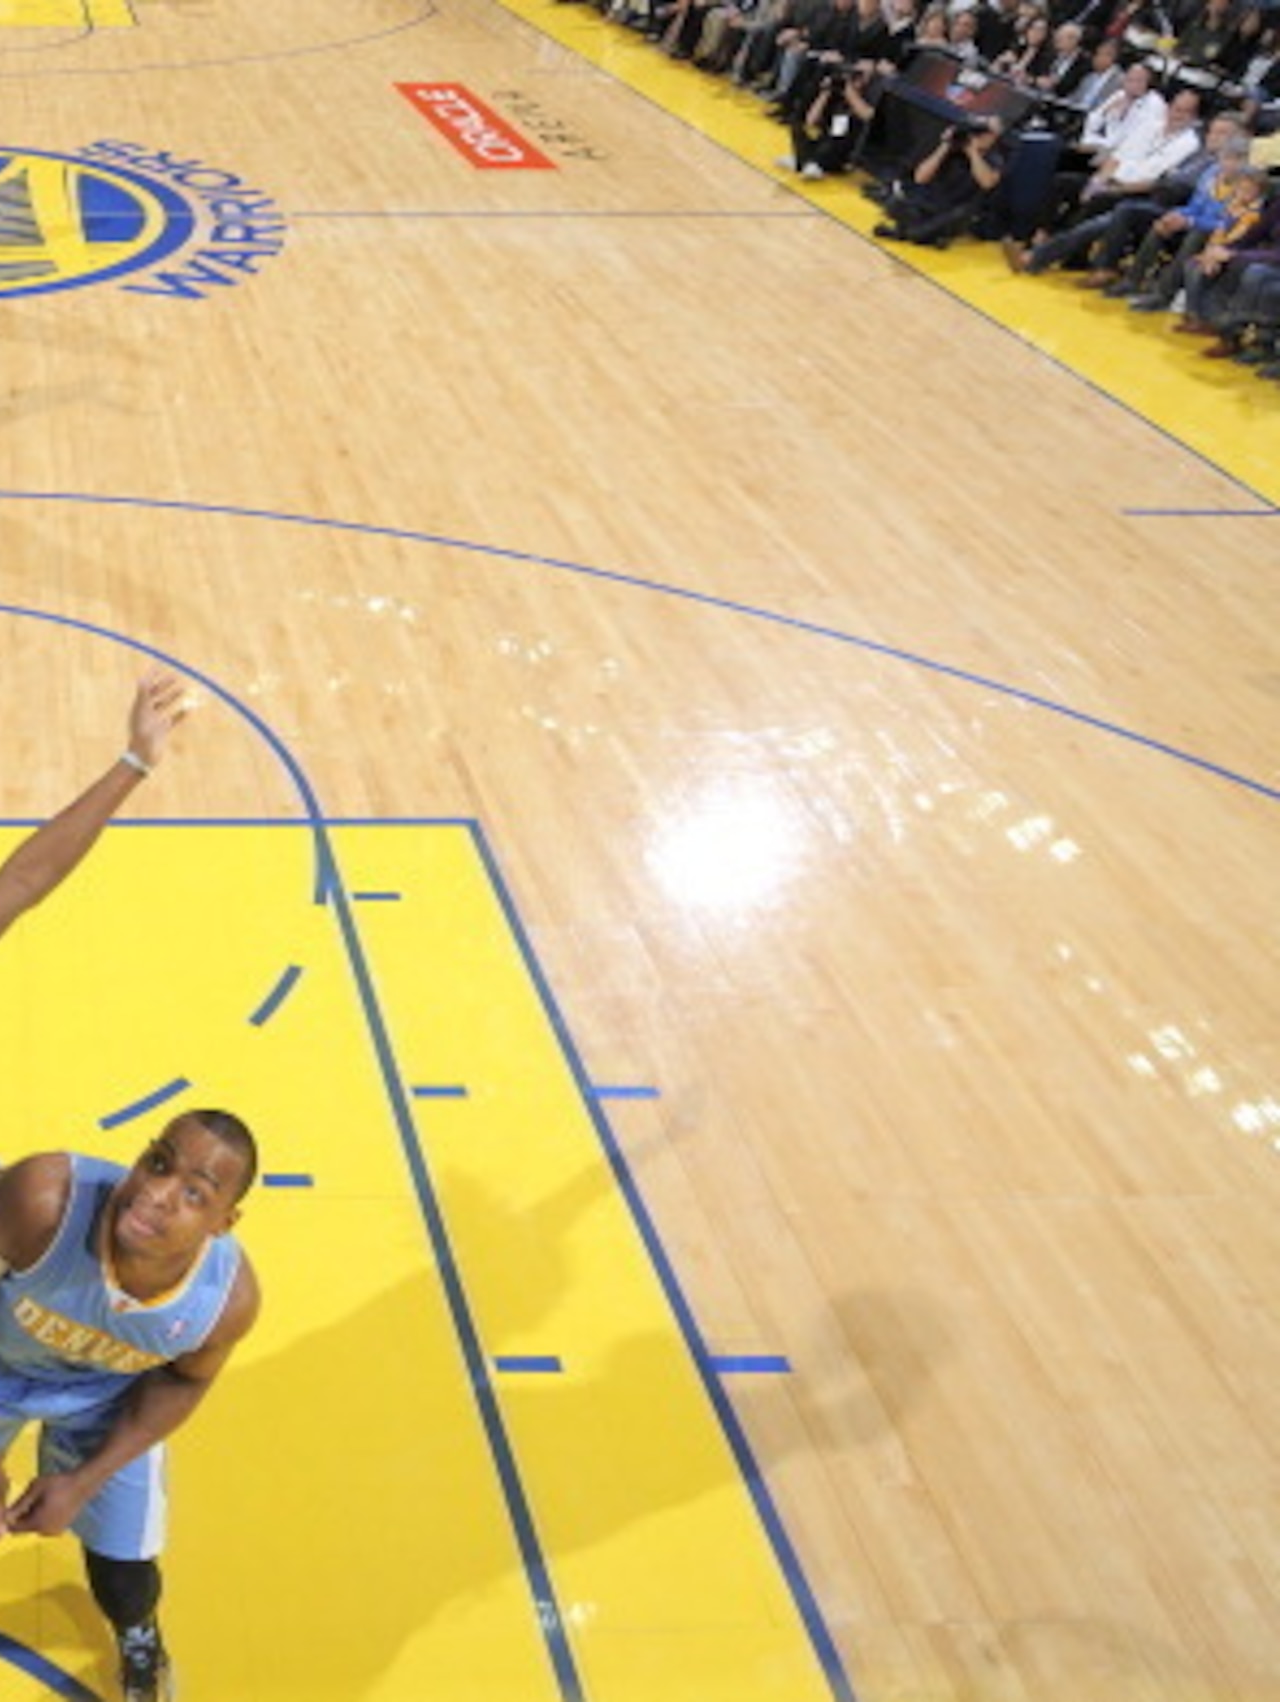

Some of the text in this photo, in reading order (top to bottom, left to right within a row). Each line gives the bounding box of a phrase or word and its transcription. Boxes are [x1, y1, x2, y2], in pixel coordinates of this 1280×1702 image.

[415, 88, 524, 162] ORACLE
[77, 139, 287, 299] WARRIORS
[13, 1296, 167, 1374] DENVE
